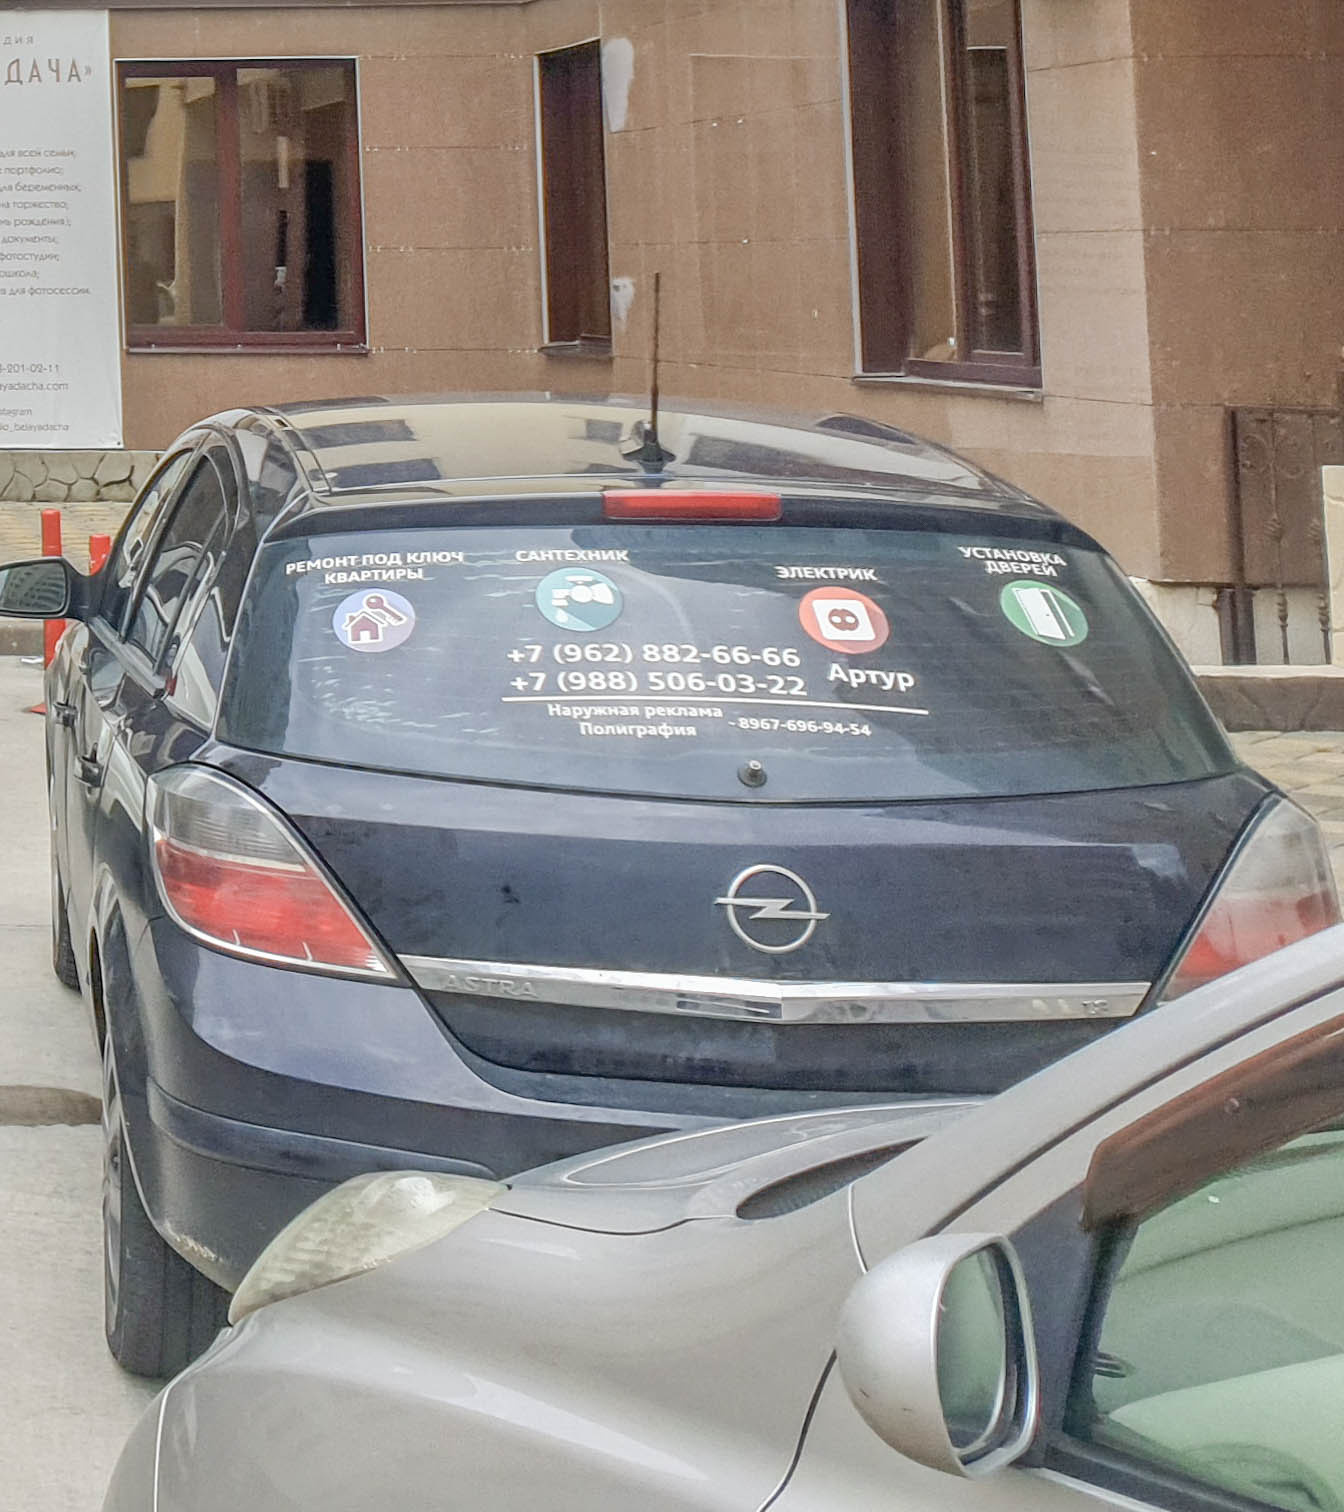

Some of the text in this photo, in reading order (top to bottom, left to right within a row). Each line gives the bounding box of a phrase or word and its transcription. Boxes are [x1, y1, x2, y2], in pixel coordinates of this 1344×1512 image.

[3, 57, 92, 86] ДАЧА»
[285, 550, 464, 575] РЕМОНТ ПОД КЛЮЧ
[514, 548, 630, 563] САНТЕХНИК
[957, 545, 1068, 567] УСТАНОВКА
[324, 567, 425, 585] КВАРТИРЫ
[774, 565, 879, 582] ЭЛЕКТРИК
[983, 559, 1058, 577] ДВЕРЕЙ
[506, 642, 801, 668] +7 (962) 882-66-66
[509, 671, 808, 697] +7 (988) 506-03-22
[826, 662, 916, 692] Артур
[547, 703, 723, 722] Наружная реклама
[579, 722, 697, 739] Полиграфия
[447, 974, 539, 999] ASTRA
